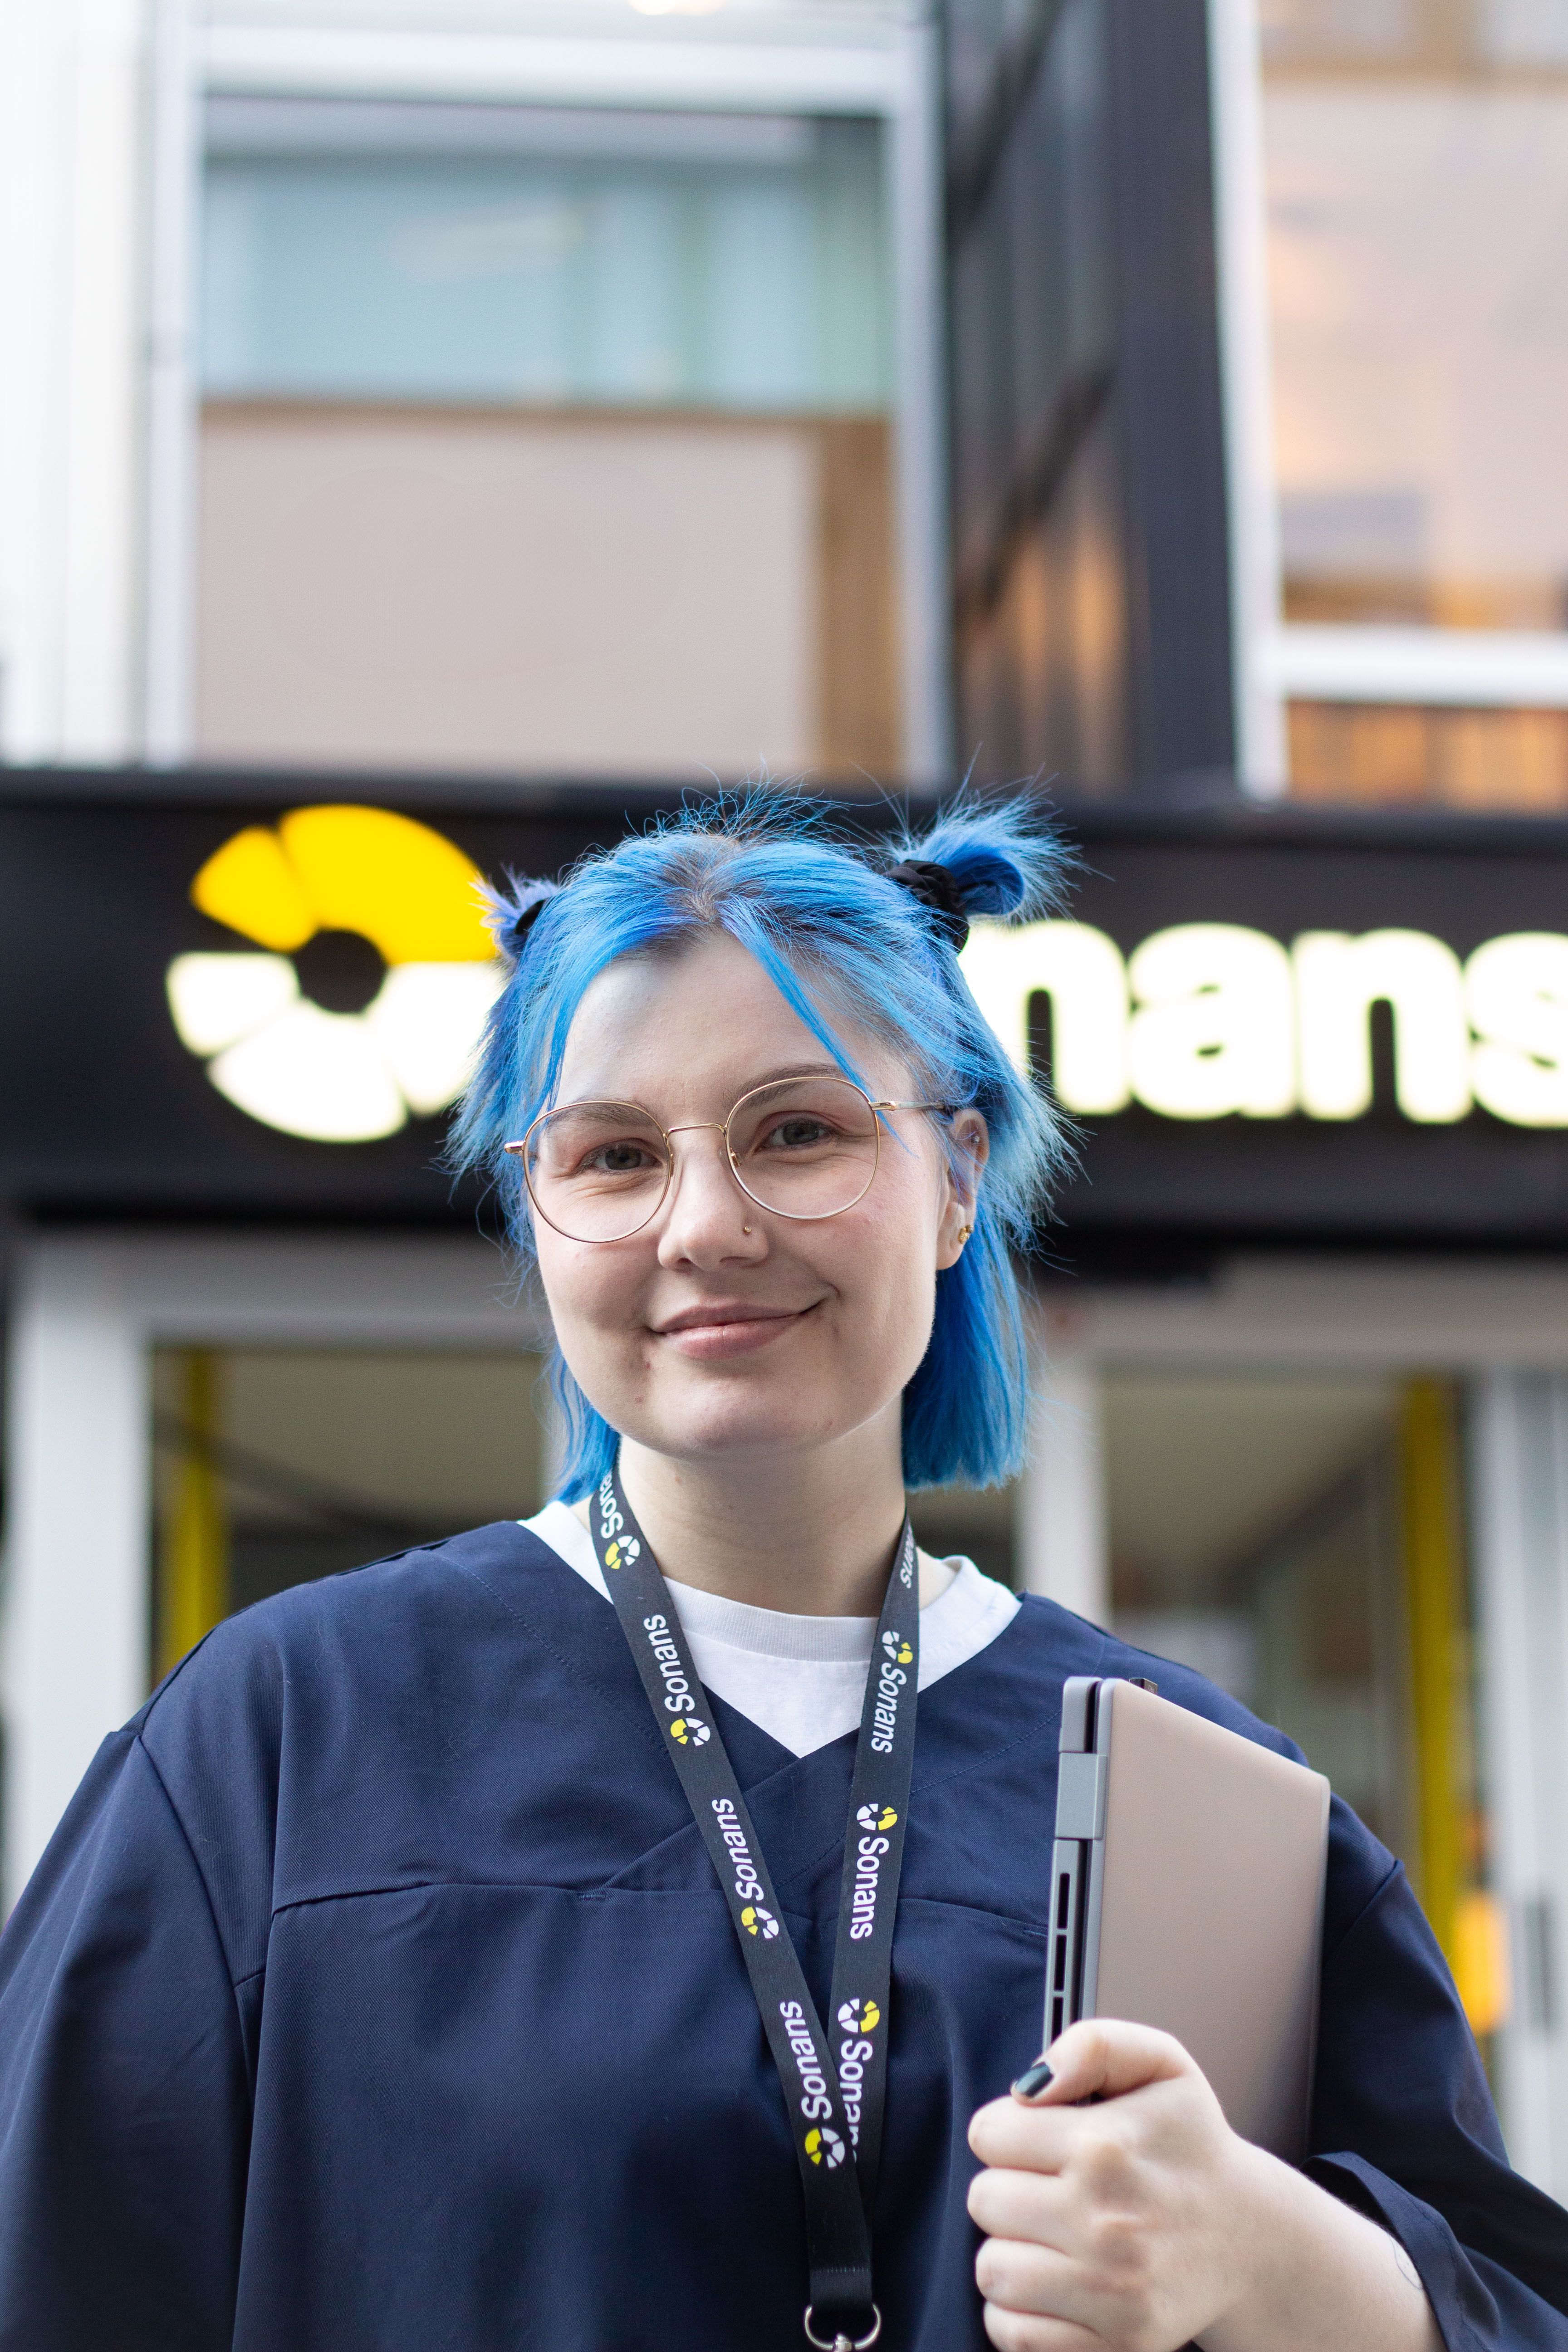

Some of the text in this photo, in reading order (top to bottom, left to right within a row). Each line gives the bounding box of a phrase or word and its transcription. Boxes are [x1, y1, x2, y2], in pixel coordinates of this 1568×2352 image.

[956, 919, 1568, 1128] nans
[599, 1468, 624, 1539] Sona
[642, 1614, 696, 1713] Sonans
[871, 1661, 907, 1754] Sonans
[711, 1798, 764, 1901] Sonans
[849, 1836, 890, 1940] Sonans
[779, 2001, 833, 2121] Sonans
[839, 2039, 873, 2163] Sona
